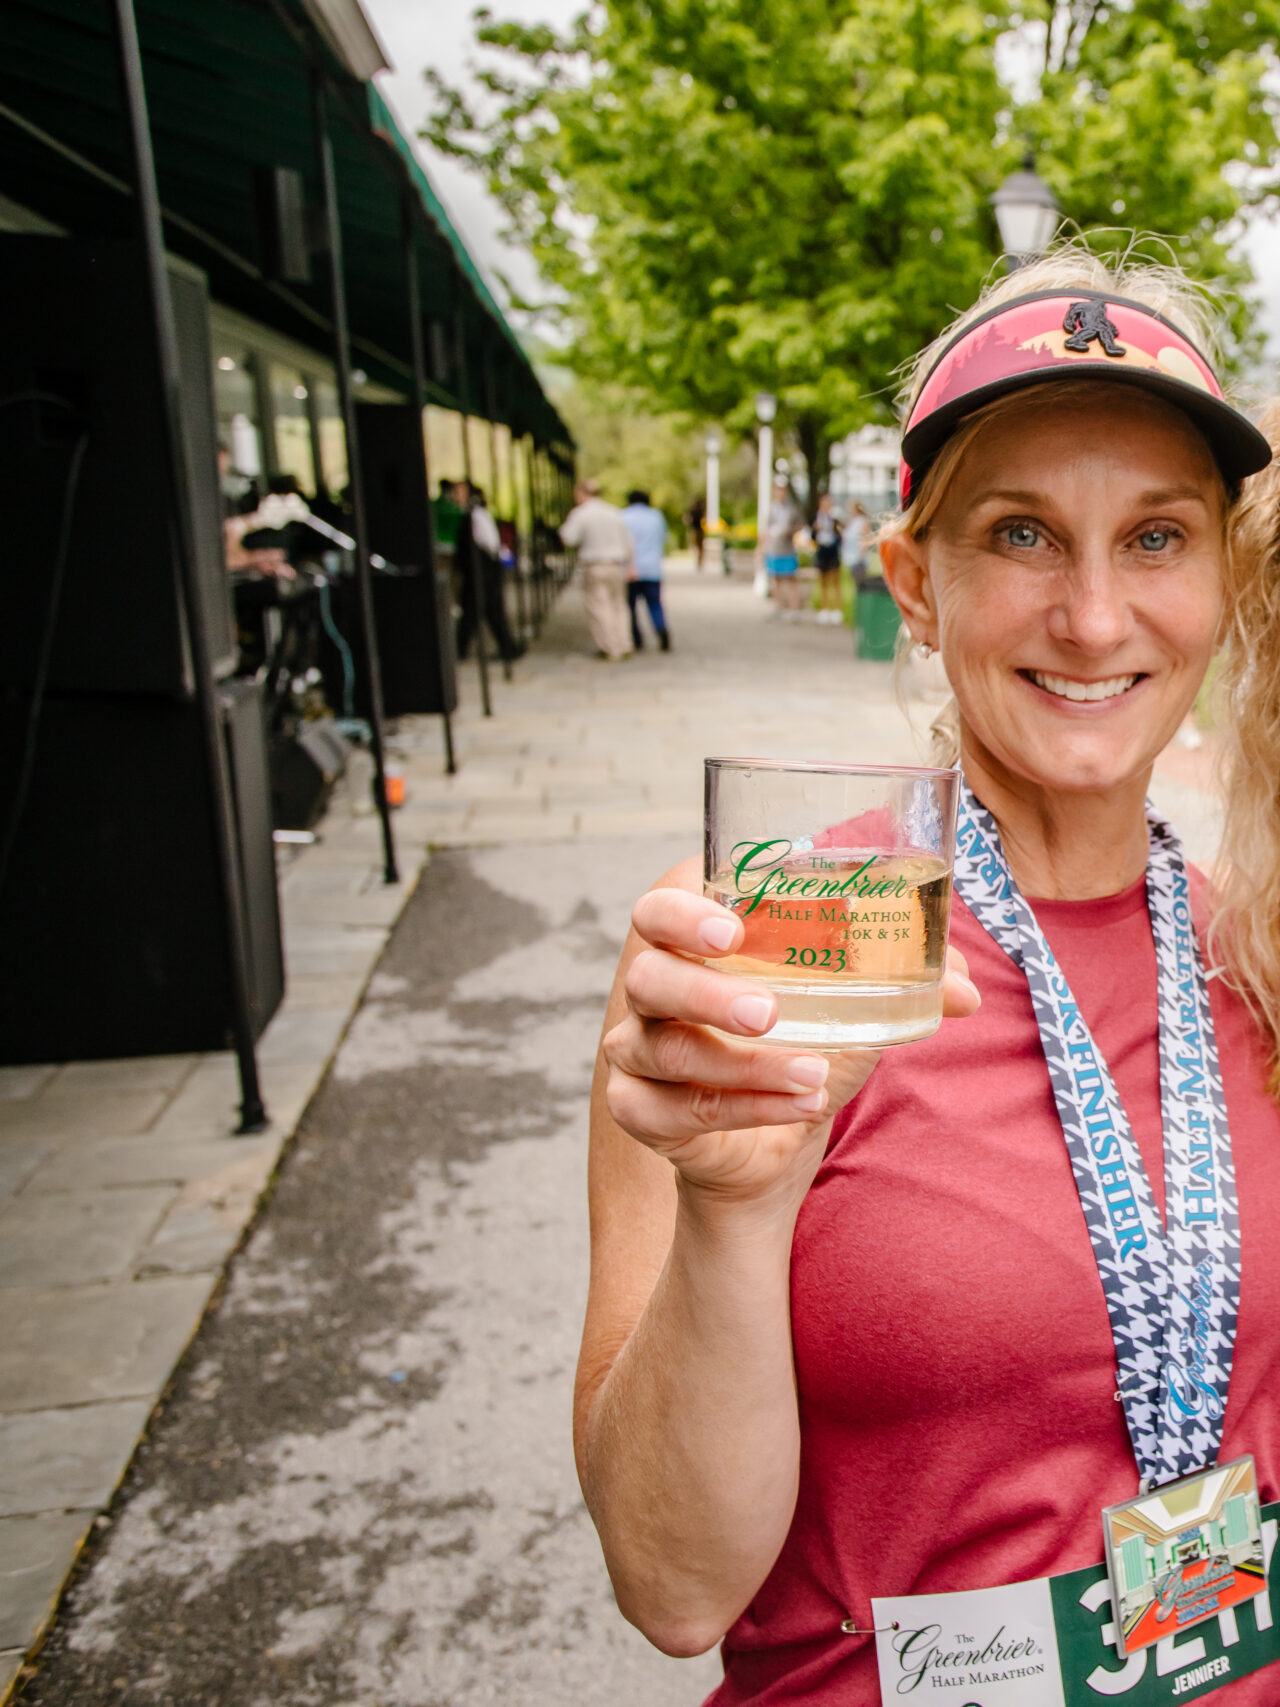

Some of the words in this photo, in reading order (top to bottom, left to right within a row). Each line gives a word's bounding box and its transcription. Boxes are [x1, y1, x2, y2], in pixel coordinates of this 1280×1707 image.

[730, 839, 910, 919] Greenbrier
[809, 857, 836, 869] The
[784, 947, 847, 973] 2023
[843, 929, 872, 940] 10K
[878, 928, 889, 940] &
[894, 928, 910, 941] 5K
[1172, 873, 1207, 1099] MARATHON
[1067, 1038, 1148, 1263] FINISHER
[1183, 1109, 1218, 1227] HALF
[891, 1624, 1038, 1694] Greenbrier
[954, 1634, 975, 1644] The
[1172, 1655, 1231, 1696] JENNIFER
